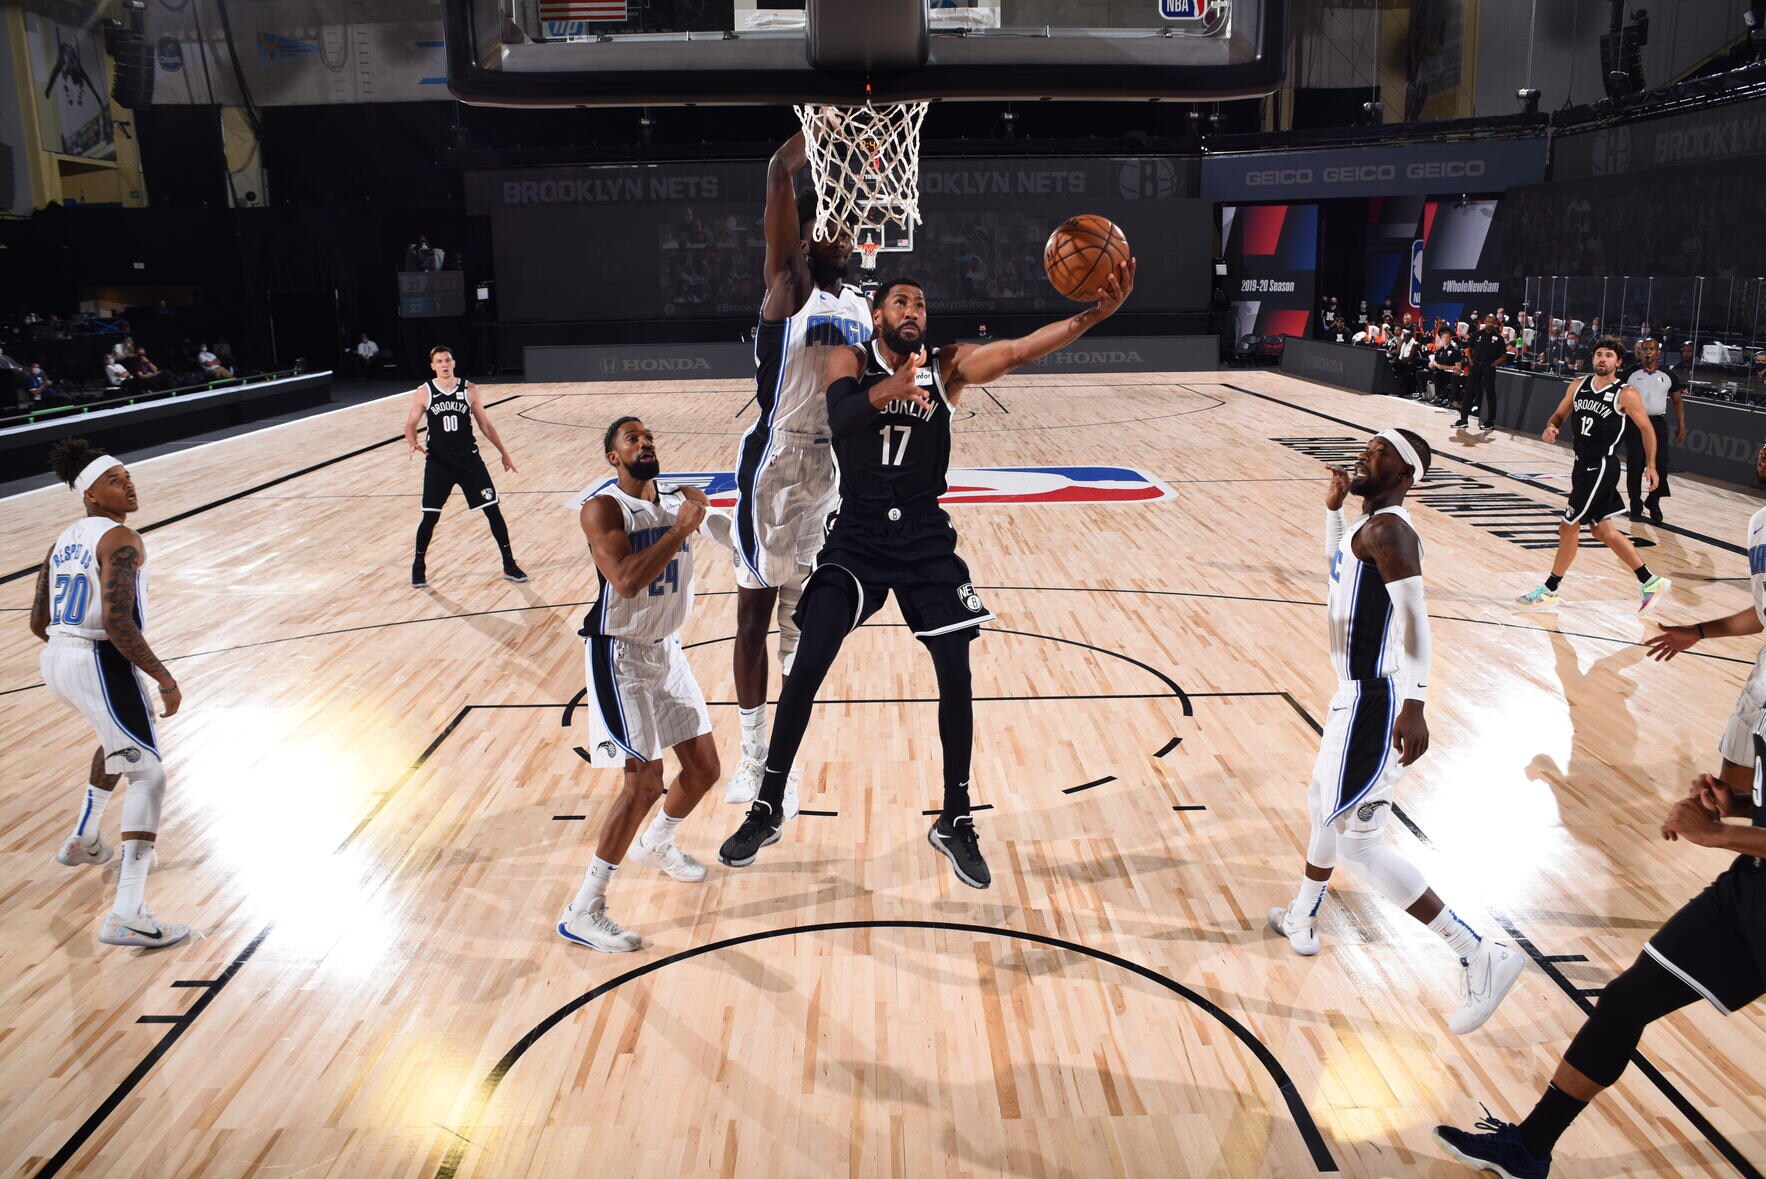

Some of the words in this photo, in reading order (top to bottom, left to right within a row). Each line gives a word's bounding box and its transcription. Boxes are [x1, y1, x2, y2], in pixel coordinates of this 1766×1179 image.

[1166, 0, 1189, 12] NBA
[1245, 169, 1313, 186] GEICO
[1323, 165, 1395, 182] GEICO
[1406, 160, 1486, 179] GEICO
[503, 177, 643, 204] BROOKLYN
[650, 176, 719, 200] NETS
[917, 171, 1012, 196] OKLYN
[1017, 171, 1087, 194] NETS
[1241, 279, 1269, 292] 2019-20
[1269, 279, 1295, 292] Season
[622, 357, 711, 371] HONDA
[1054, 351, 1144, 364] HONDA
[430, 401, 468, 415] BROOKLYN
[1573, 399, 1612, 418] BROOKLYN
[442, 415, 458, 432] 00
[1580, 416, 1594, 437] 12
[879, 424, 912, 466] 17
[648, 558, 679, 597] 24
[52, 573, 88, 626] 20
